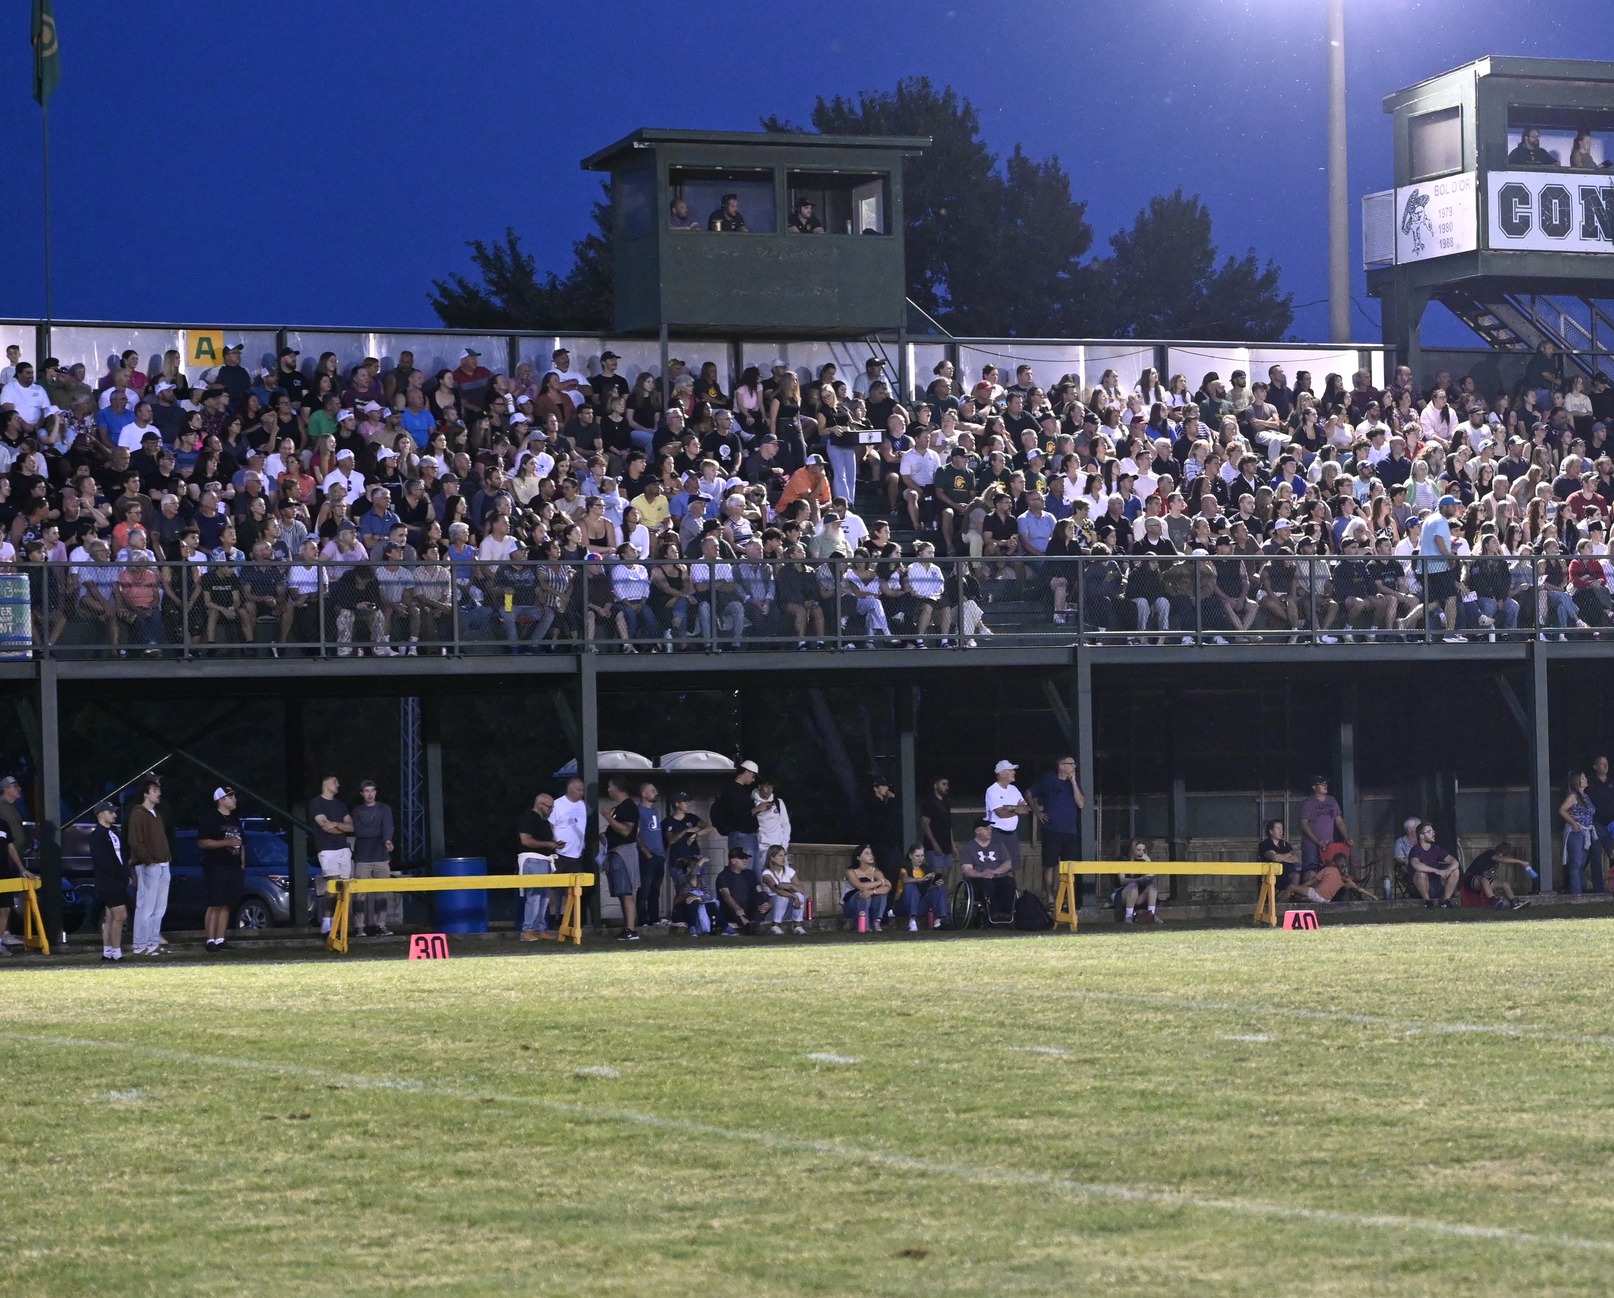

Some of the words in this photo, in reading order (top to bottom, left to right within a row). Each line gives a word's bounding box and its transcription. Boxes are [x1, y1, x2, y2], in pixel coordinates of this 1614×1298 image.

[1434, 184, 1450, 197] BOL
[1451, 178, 1471, 193] D'OR
[1438, 206, 1453, 219] 1979
[1438, 222, 1454, 235] 1980
[194, 336, 217, 360] A
[1291, 912, 1318, 930] 40
[415, 936, 447, 960] 30
